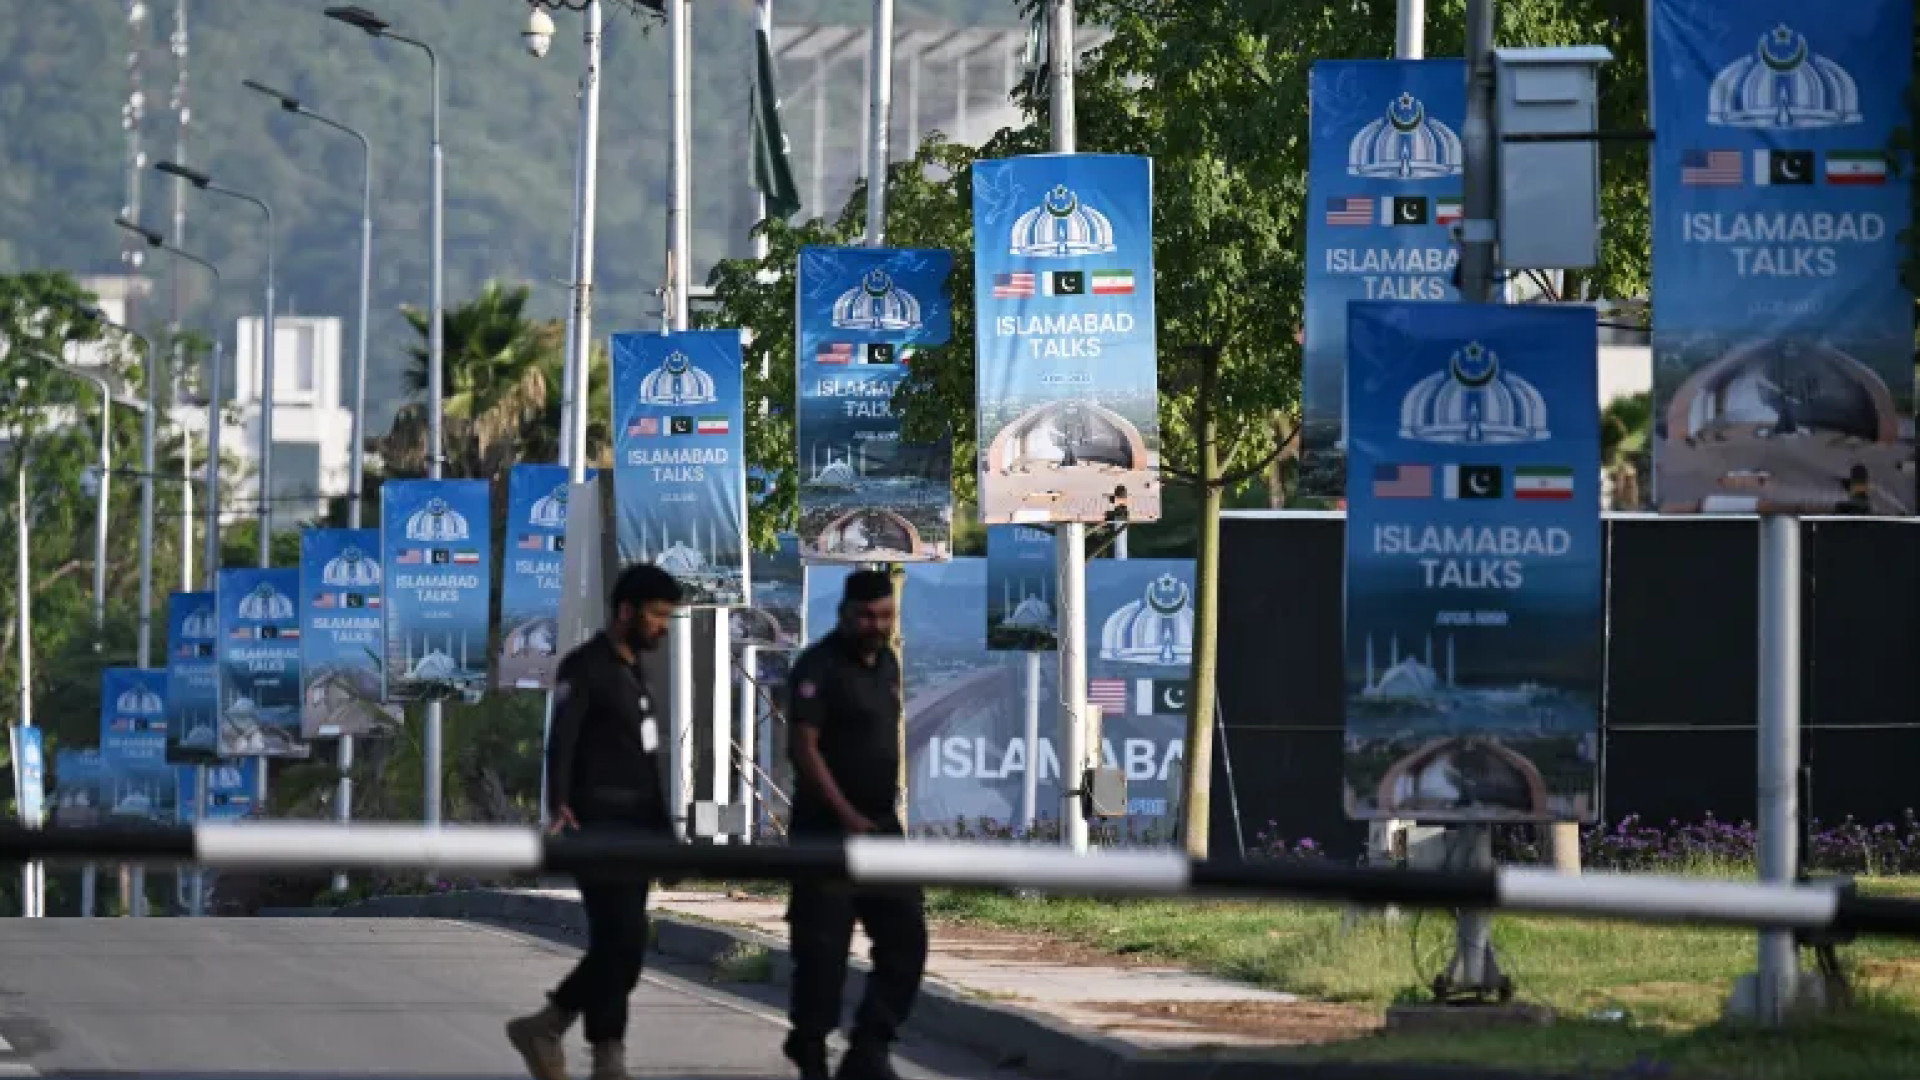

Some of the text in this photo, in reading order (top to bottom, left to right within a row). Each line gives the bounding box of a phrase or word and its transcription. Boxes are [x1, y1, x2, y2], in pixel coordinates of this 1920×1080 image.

[1682, 211, 1886, 242] ISLAMABAD
[1326, 248, 1460, 272] ISLAMABA
[1731, 246, 1838, 277] TALKS
[1363, 275, 1445, 300] TALKS
[996, 313, 1134, 337] ISLAMABAD
[1029, 337, 1102, 360] TALKS
[627, 447, 729, 466] ISLAMABAD
[652, 465, 704, 482] TALKS
[1373, 523, 1572, 557] ISLAMABAD
[515, 560, 562, 575] ISLAM
[1417, 557, 1524, 589] TALKS
[396, 575, 479, 589] ISLAMABAD
[535, 574, 562, 589] TAL
[416, 588, 460, 603] TALKS
[312, 617, 380, 629] ISLAMABA
[929, 736, 1184, 781] ISLAMBA
